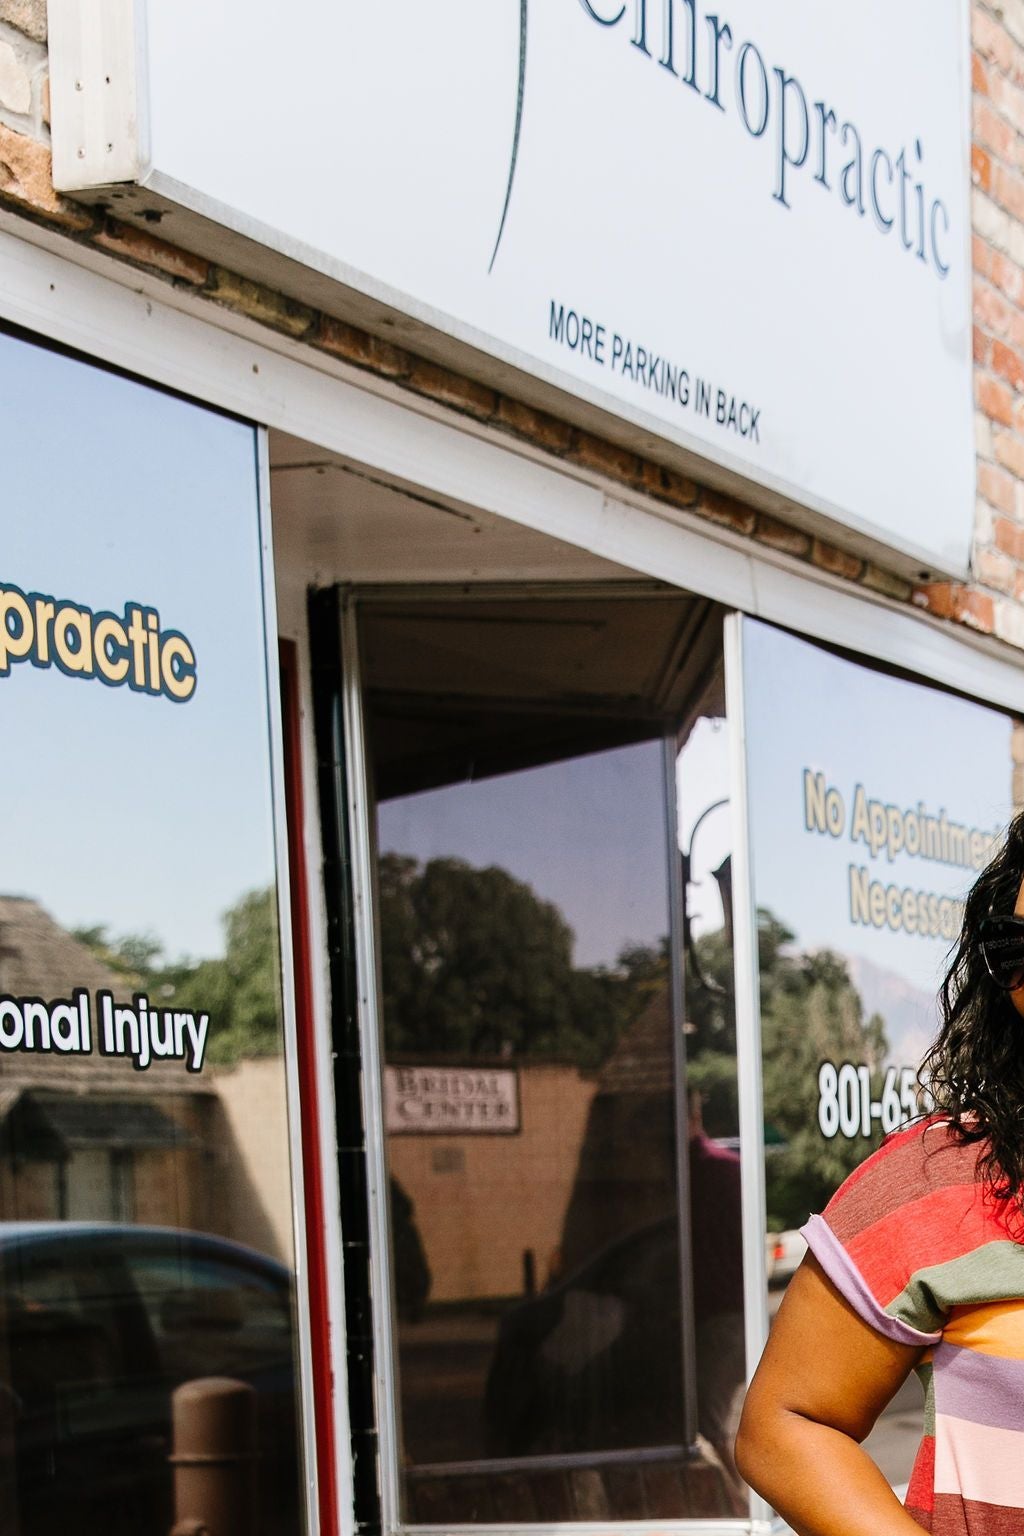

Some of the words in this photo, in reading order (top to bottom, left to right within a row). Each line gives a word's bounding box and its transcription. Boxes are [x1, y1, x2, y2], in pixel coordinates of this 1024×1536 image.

[577, 0, 950, 280] iropractic
[548, 298, 606, 366] MORE
[610, 333, 691, 408] PARKING
[694, 376, 713, 420] IN
[715, 388, 762, 444] BACK
[0, 586, 197, 701] practic
[803, 767, 846, 839] No
[0, 991, 92, 1053] onal
[99, 993, 210, 1071] Injury
